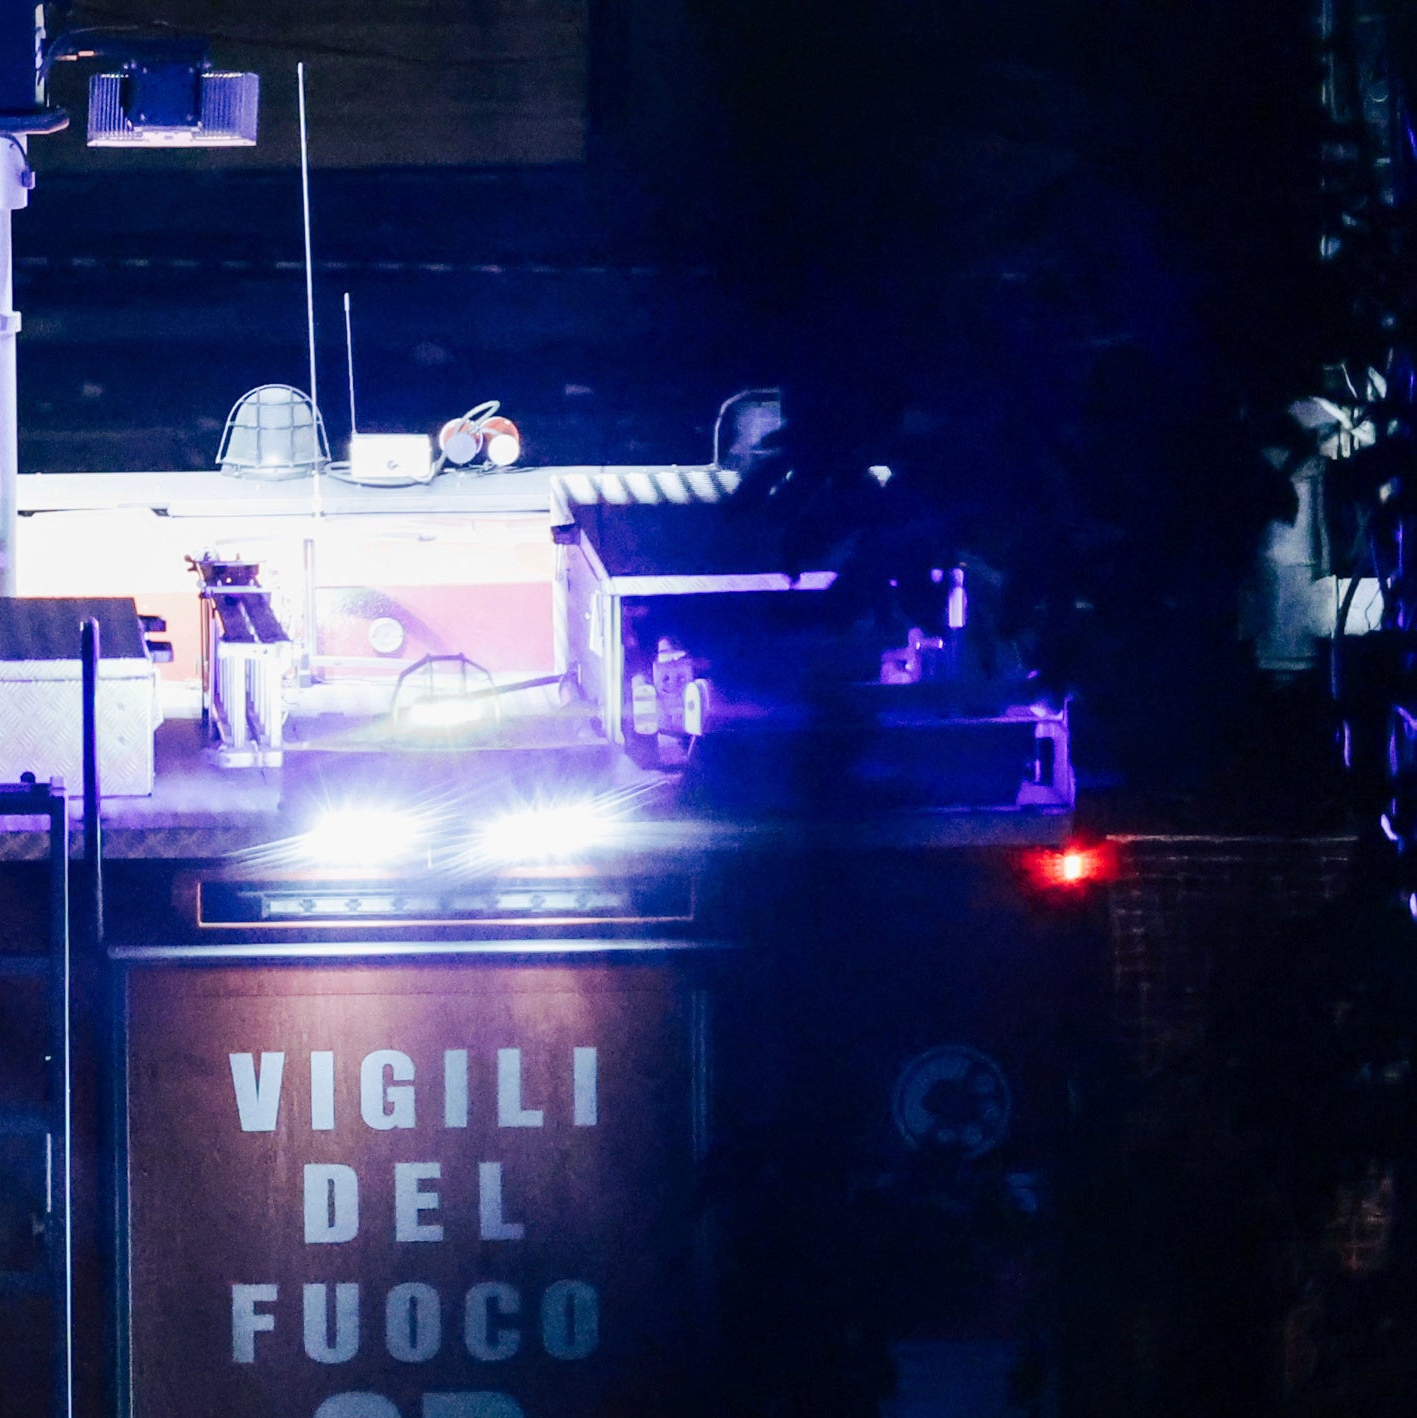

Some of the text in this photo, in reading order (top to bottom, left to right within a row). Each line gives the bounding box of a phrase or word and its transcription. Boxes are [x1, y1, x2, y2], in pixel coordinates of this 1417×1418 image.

[228, 1045, 599, 1132] VIGILI
[302, 1161, 526, 1244] DEL
[230, 1278, 601, 1364] FUOCO
